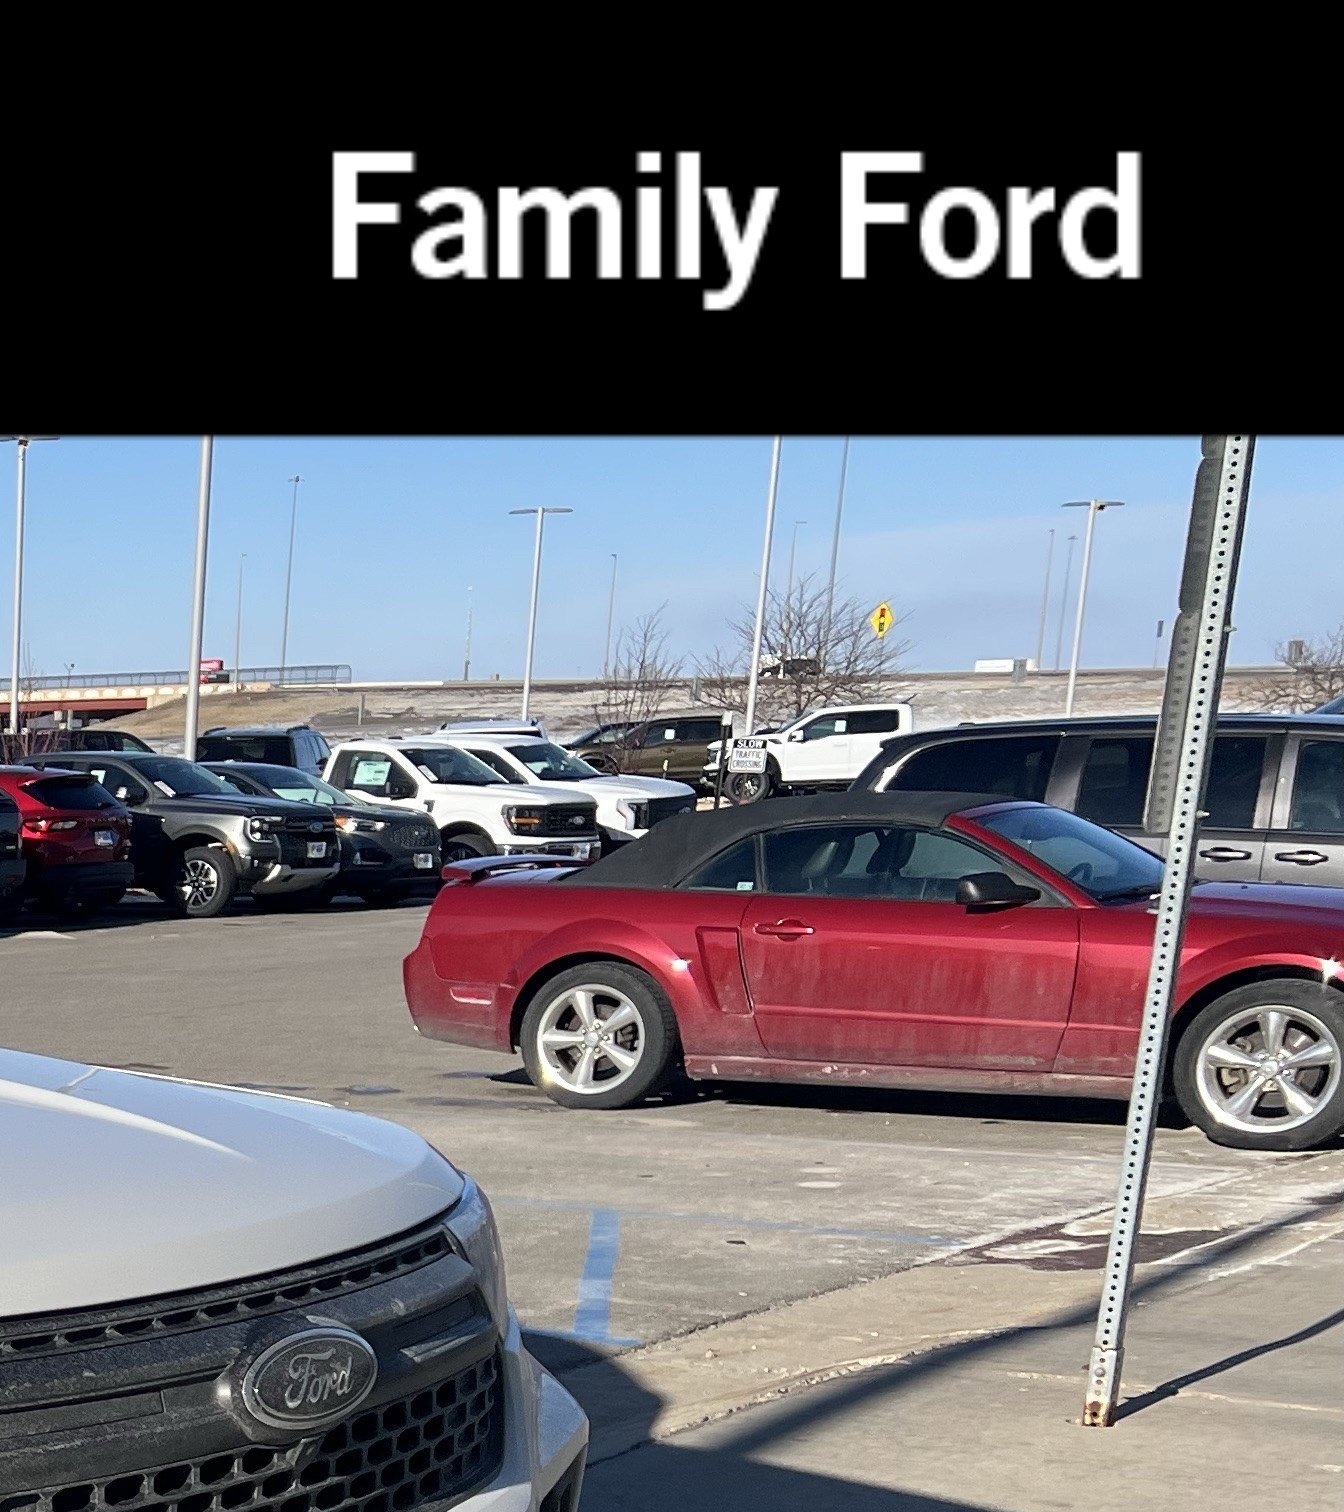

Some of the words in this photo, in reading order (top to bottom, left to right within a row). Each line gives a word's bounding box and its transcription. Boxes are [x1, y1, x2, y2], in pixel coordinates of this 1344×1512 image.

[737, 739, 763, 748] SLOW
[735, 750, 762, 759] TRAFFIC
[284, 1347, 353, 1409] Ford
